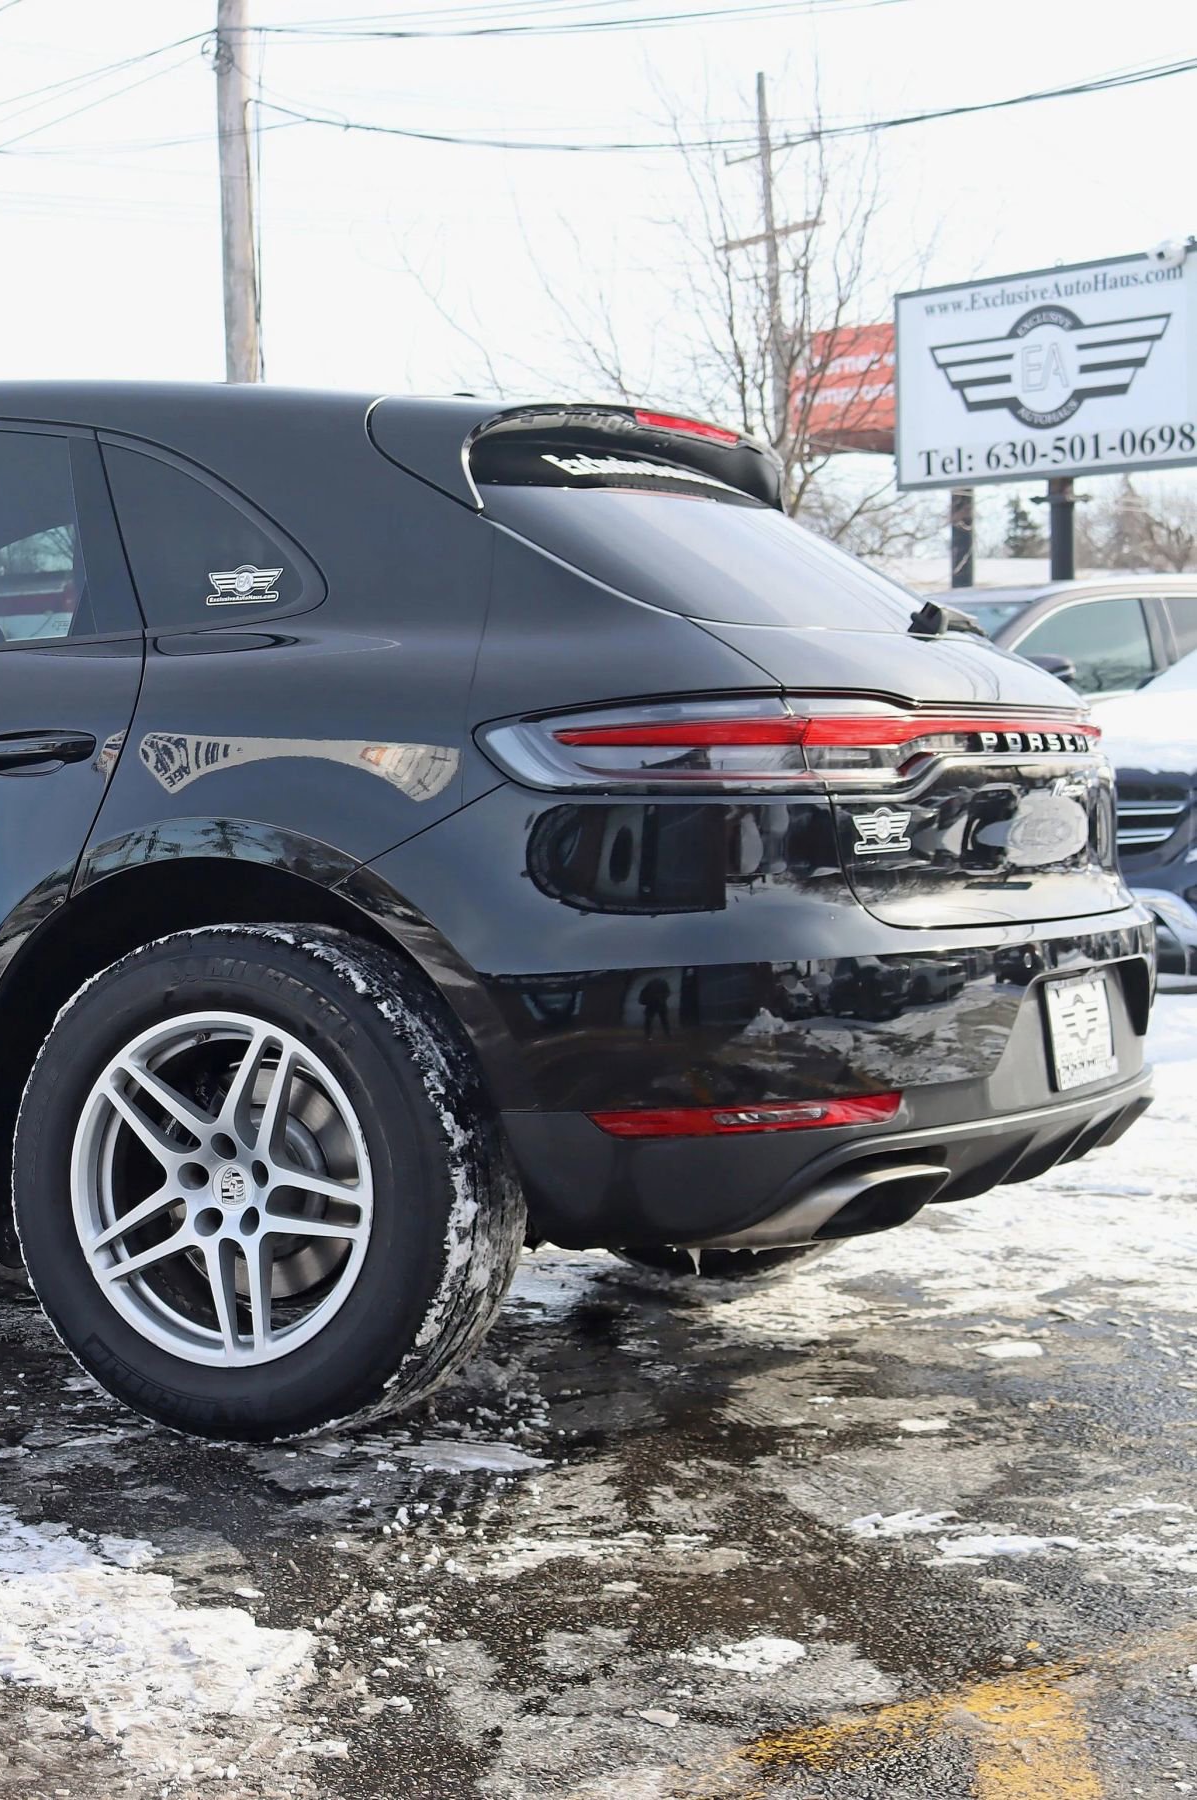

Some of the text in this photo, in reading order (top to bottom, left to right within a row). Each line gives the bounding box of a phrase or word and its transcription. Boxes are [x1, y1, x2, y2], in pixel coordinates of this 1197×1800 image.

[924, 264, 1184, 316] www.ExclusiveAutoHaus.com
[1016, 310, 1074, 337] EXCLUSIVE
[1021, 342, 1070, 393] EA
[1017, 398, 1080, 425] AUTOHAUS
[918, 423, 1196, 477] Tel: 630-501-0698
